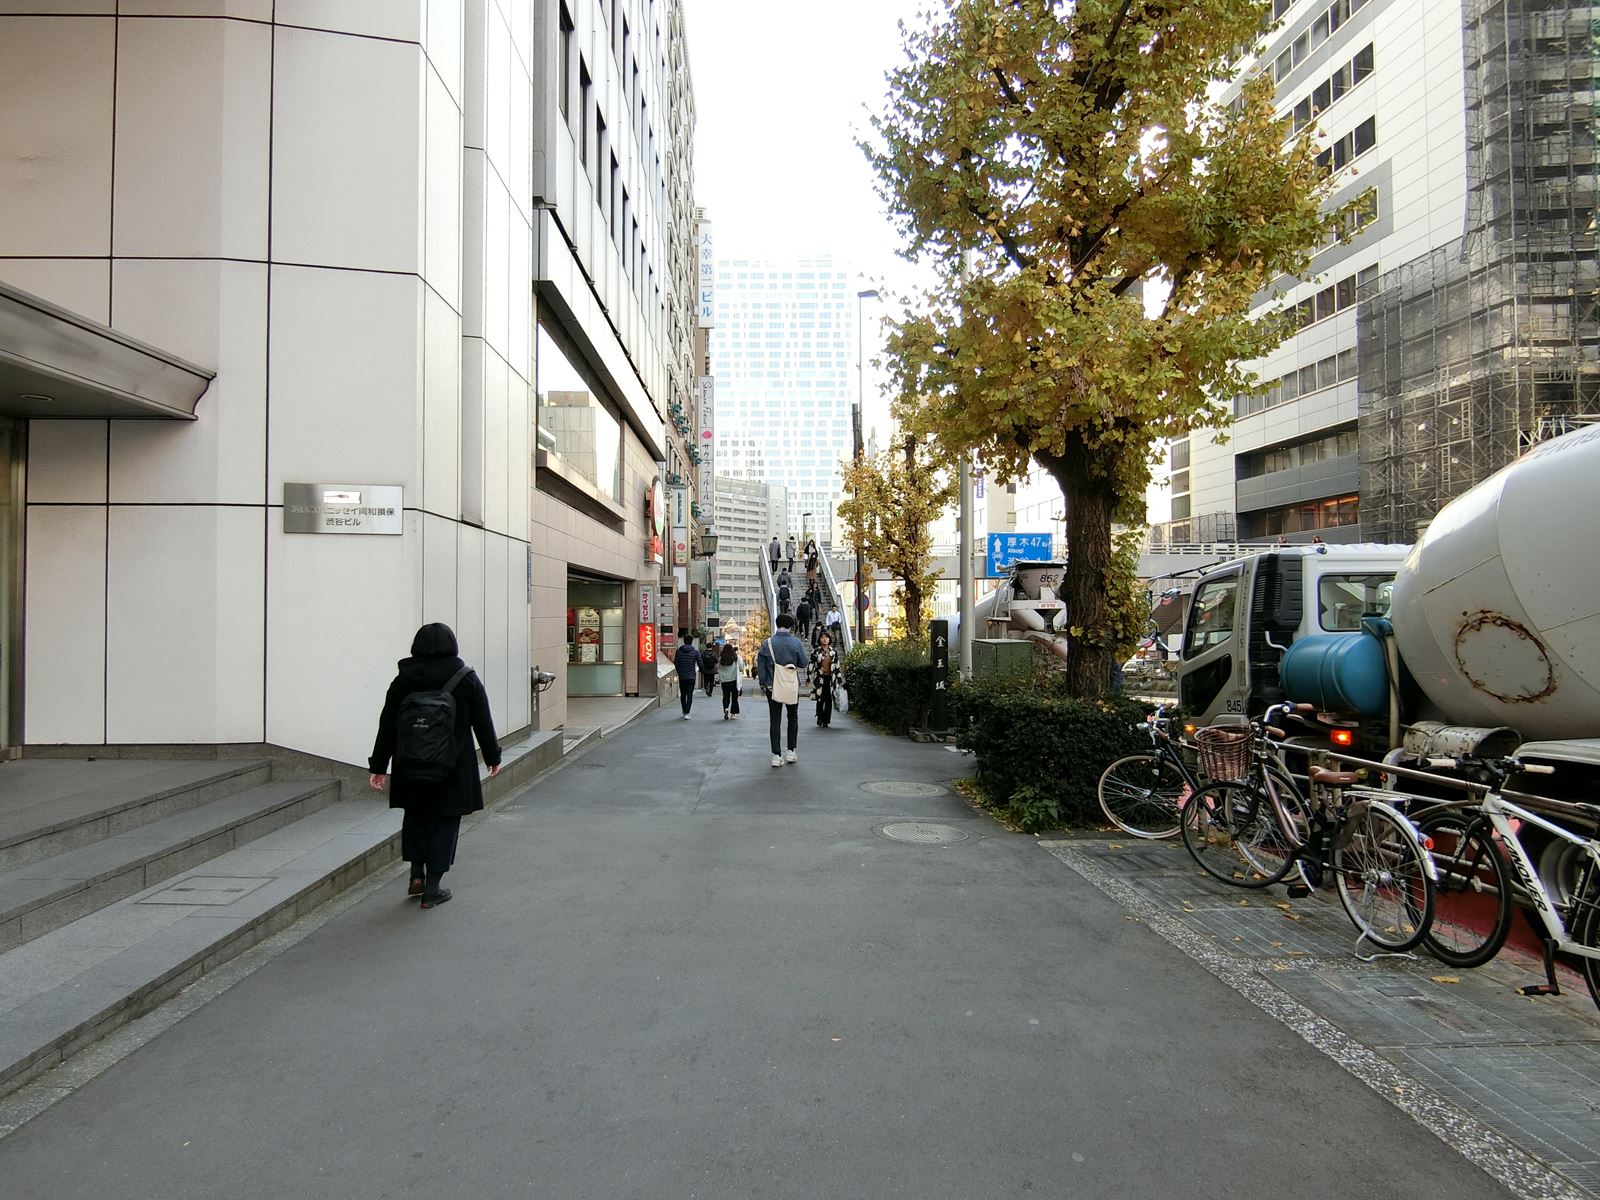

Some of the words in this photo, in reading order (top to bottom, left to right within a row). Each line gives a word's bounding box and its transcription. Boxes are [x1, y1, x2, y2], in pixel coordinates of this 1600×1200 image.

[325, 517, 362, 527] 渋谷ビル
[1030, 537, 1042, 547] 47
[645, 625, 653, 662] NOAH
[1226, 699, 1242, 713] 845
[1501, 833, 1548, 912] CANOVER
